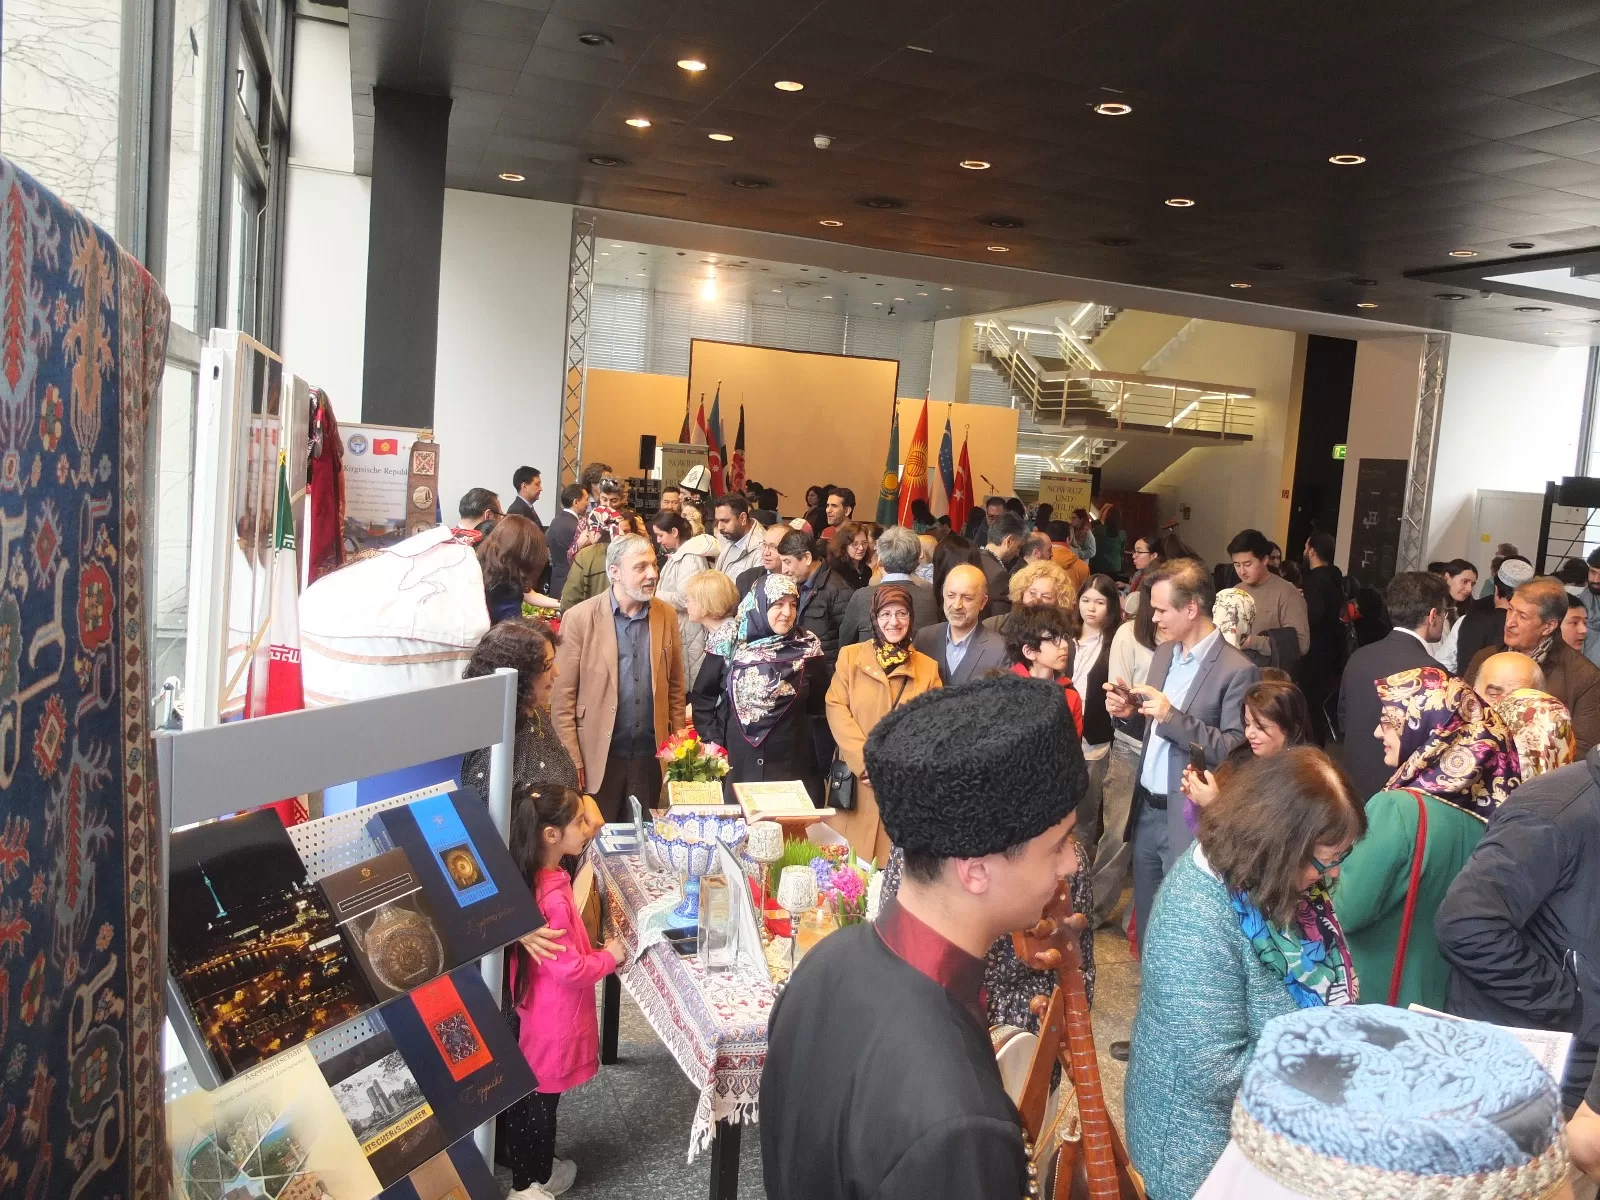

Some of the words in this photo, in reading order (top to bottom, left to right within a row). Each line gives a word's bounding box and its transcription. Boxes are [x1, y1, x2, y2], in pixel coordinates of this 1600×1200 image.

[344, 465, 382, 474] Kirgisische
[384, 467, 407, 476] Republ
[1047, 486, 1083, 494] NOWRUZ
